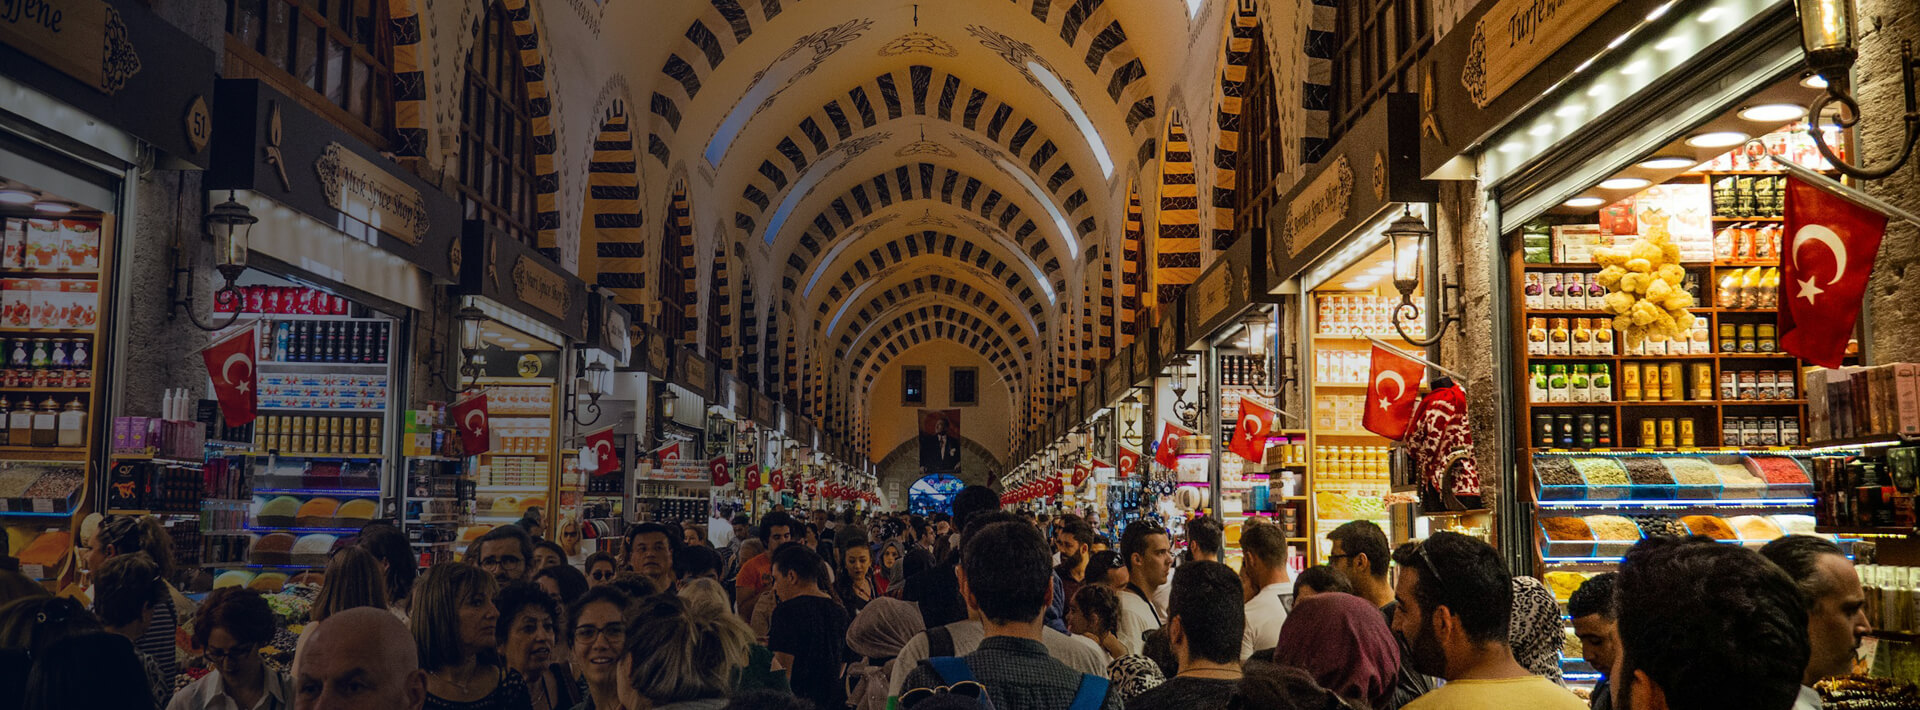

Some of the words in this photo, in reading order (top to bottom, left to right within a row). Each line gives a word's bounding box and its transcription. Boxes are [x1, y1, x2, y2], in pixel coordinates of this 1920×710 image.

[193, 112, 205, 139] 51
[368, 180, 391, 211] Spice
[392, 194, 414, 229] Shop
[522, 360, 539, 374] 55
